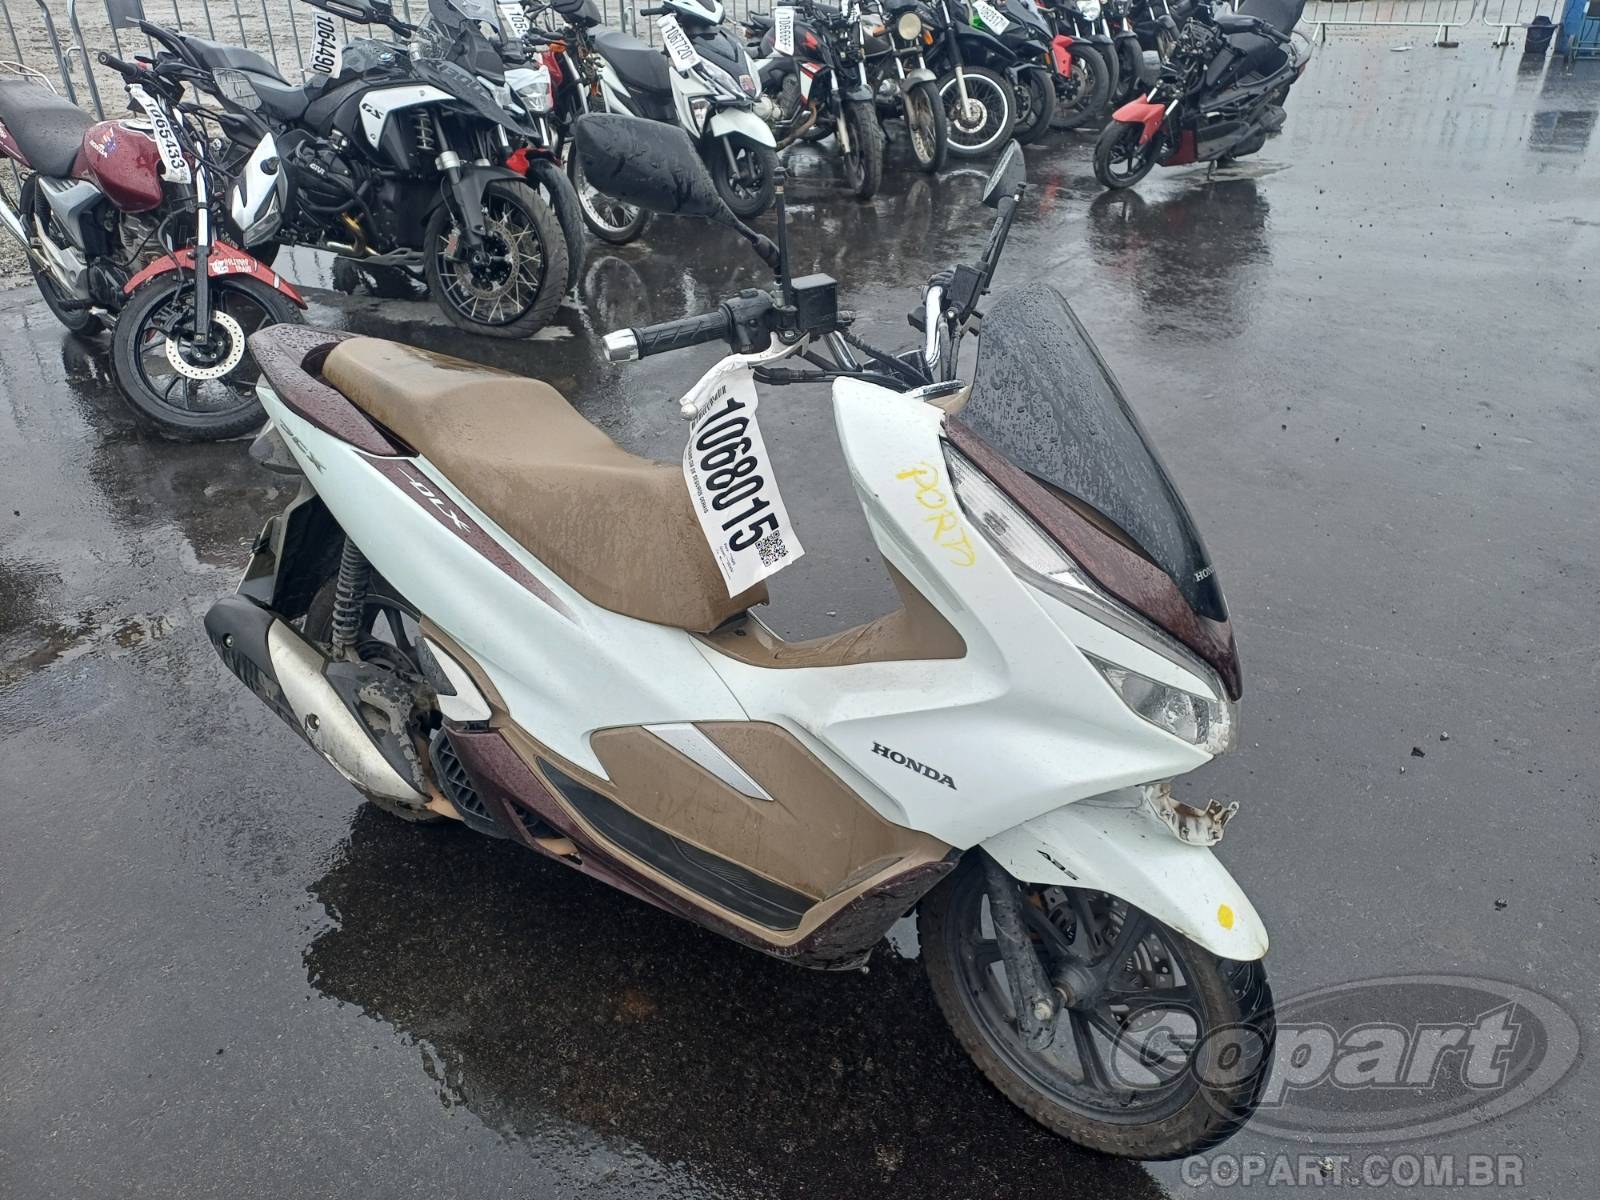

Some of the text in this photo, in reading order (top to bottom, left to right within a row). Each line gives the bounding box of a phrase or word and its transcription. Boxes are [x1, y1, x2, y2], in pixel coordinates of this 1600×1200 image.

[312, 15, 336, 74] 1064490
[665, 25, 693, 60] 1067720
[145, 103, 186, 169] 1065433
[361, 102, 384, 120] GS
[696, 397, 779, 552] 1068015
[871, 741, 958, 791] HONDA
